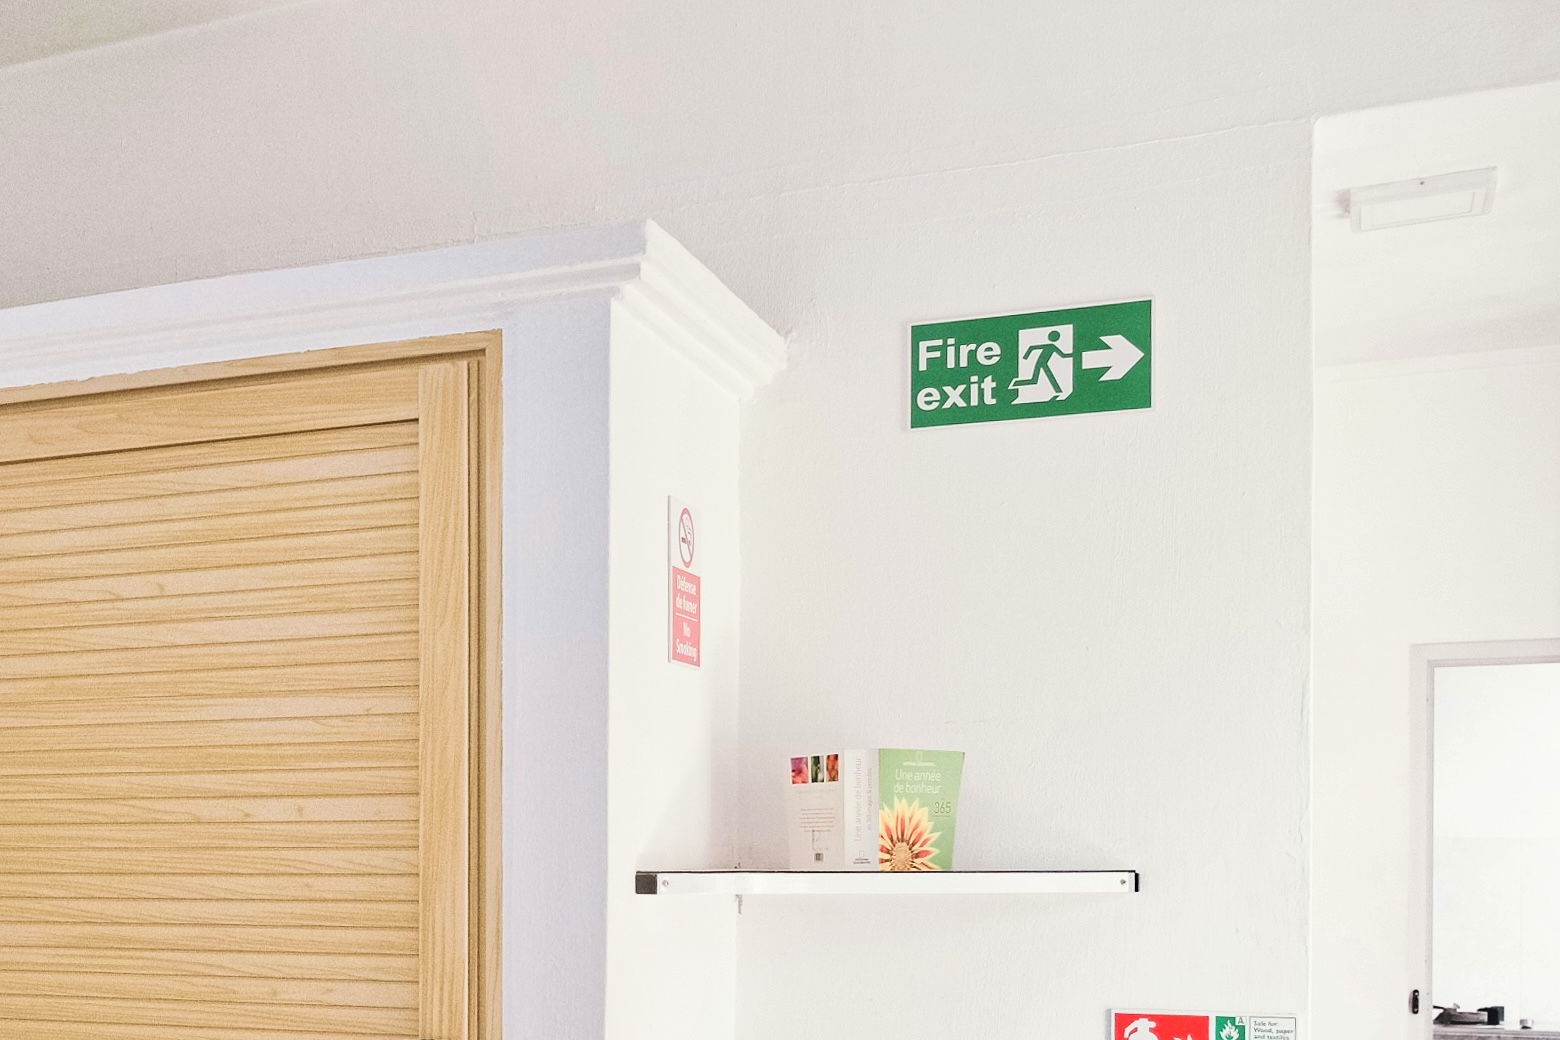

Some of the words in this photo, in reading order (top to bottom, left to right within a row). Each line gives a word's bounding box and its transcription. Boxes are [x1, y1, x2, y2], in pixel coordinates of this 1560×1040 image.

[918, 337, 1001, 371] Fire
[916, 374, 997, 411] exit
[934, 801, 951, 814] 365
[1237, 1016, 1245, 1025] A
